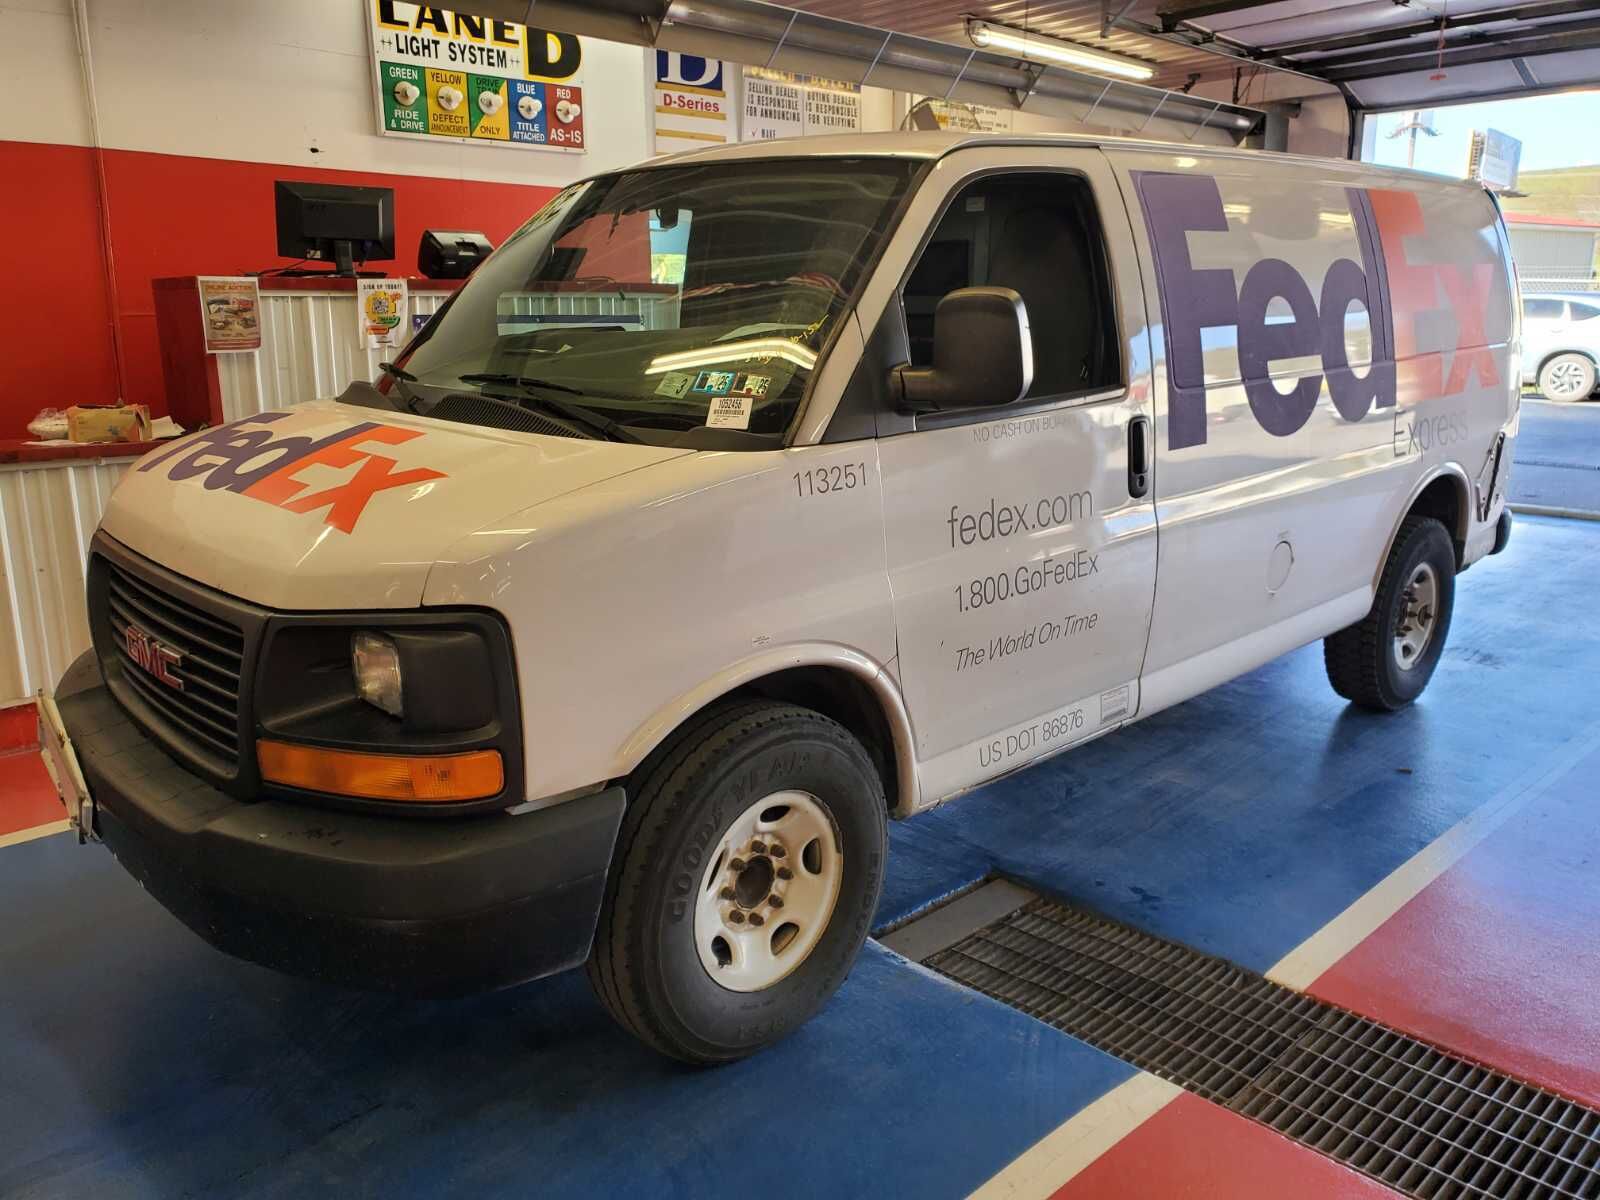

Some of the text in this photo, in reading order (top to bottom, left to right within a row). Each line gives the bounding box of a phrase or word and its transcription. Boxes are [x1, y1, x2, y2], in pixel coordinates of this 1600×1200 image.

[395, 33, 508, 69] LIGHT SYSTEM
[526, 25, 583, 79] D
[389, 66, 418, 80] GREEN
[430, 71, 462, 85] YELLOW
[476, 77, 500, 88] DRIVE
[516, 83, 536, 95] BLUE
[748, 82, 799, 99] SELLING DEALER
[556, 88, 571, 99] RED
[832, 94, 856, 107] DEALER
[663, 93, 720, 113] D-Series
[757, 95, 800, 111] RESPONSIBLE
[815, 103, 859, 118] RESPONSIBLE
[394, 109, 419, 120] RIDE
[432, 112, 464, 125] DEFECT
[746, 105, 801, 123] FOR ANNOUNCING
[808, 113, 856, 129] FOR VERIFYING
[391, 119, 425, 132] & DRIVE
[479, 125, 501, 136] ONLY
[516, 121, 540, 132] TITLE
[512, 130, 545, 143] ATTACHED
[550, 129, 582, 144] AS-IS
[1129, 170, 1501, 451] FedEx
[972, 427, 990, 442] NO
[992, 422, 1021, 440] CASH
[1024, 417, 1040, 434] ON
[1393, 408, 1469, 464] Express
[137, 412, 449, 535] FedEx
[793, 462, 867, 497] 113251
[947, 490, 1093, 548] fedex.com
[954, 550, 1099, 613] 1.800.GoFedEx
[956, 612, 1098, 672] The World On Time
[126, 624, 185, 691] GMC
[978, 709, 1084, 767] US DOT 86876
